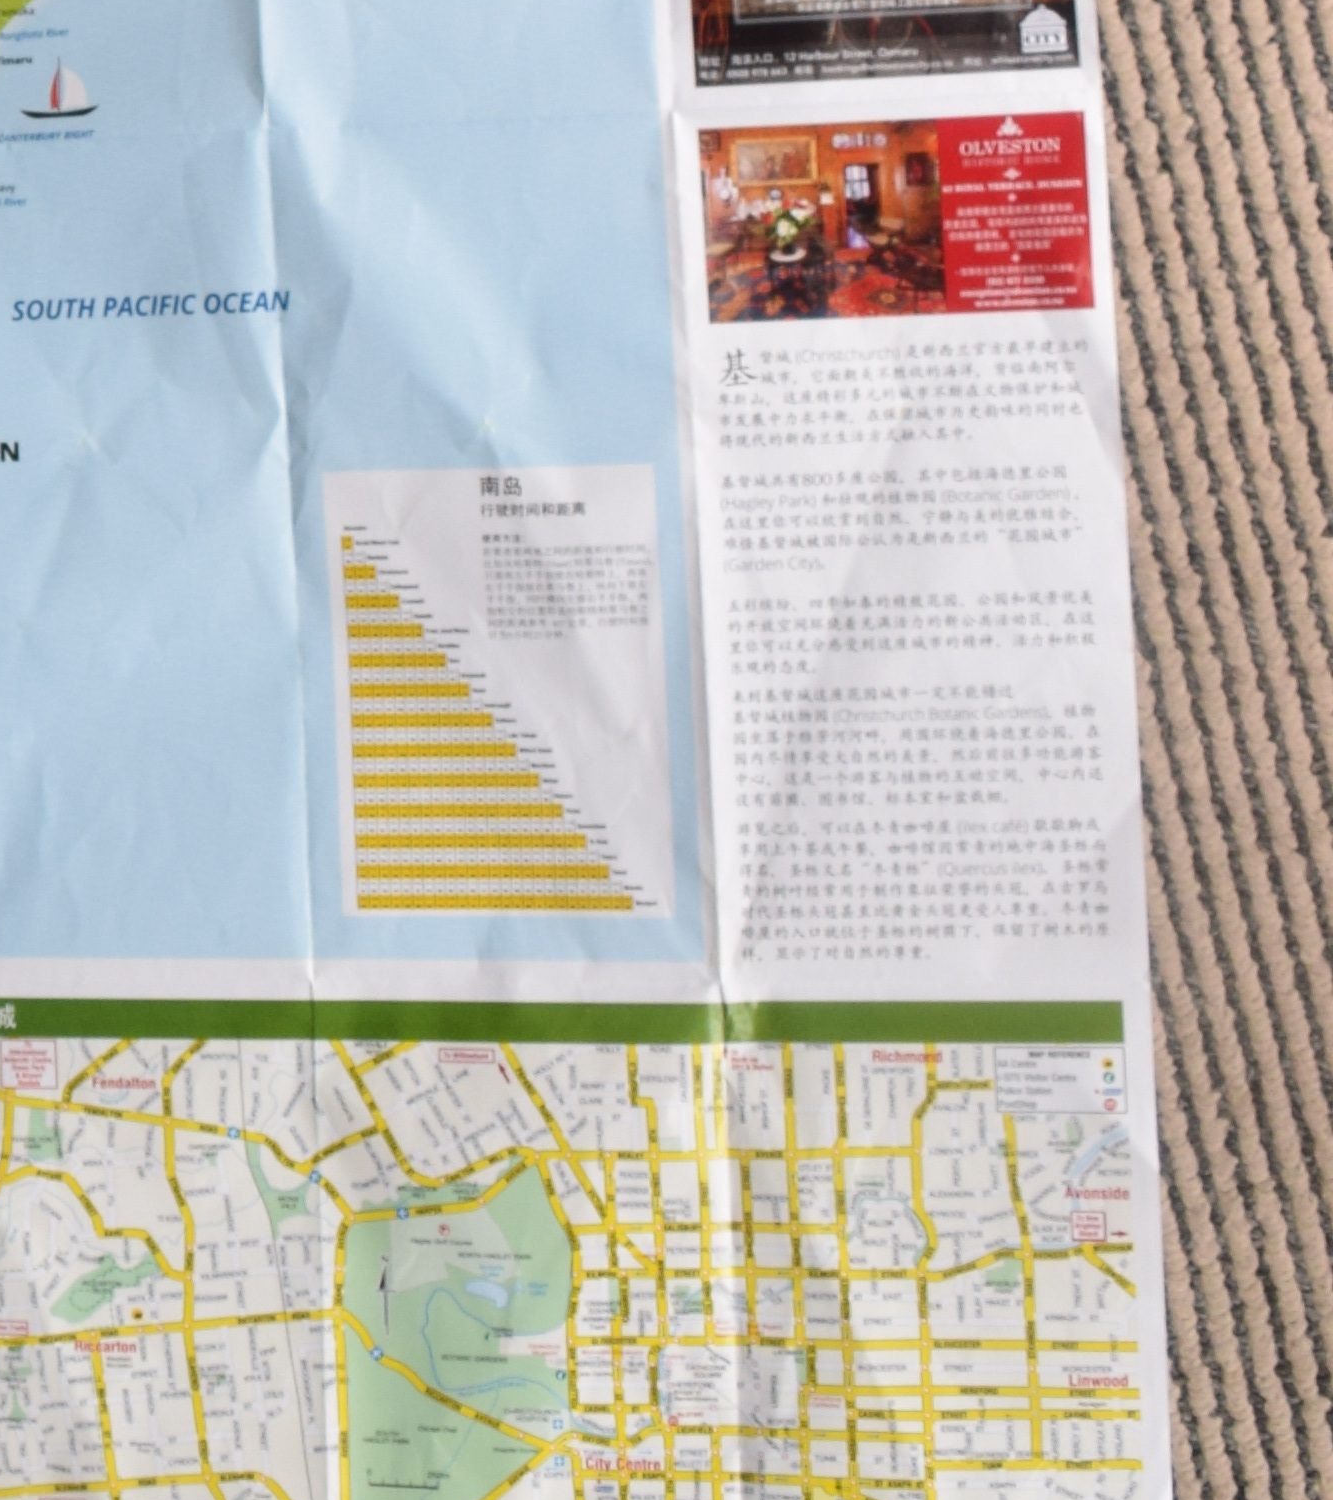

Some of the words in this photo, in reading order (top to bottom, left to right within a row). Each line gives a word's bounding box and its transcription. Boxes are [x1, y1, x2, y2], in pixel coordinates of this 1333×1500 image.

[959, 137, 1061, 156] OLVESTON
[12, 299, 95, 322] SOUTH
[102, 295, 197, 319] PACIFIC
[203, 291, 290, 316] OCEAN
[719, 348, 760, 389] 基
[479, 475, 522, 497] 南岛
[871, 1048, 944, 1065] Richmond
[91, 1075, 156, 1091] Fendalton
[1064, 1186, 1131, 1202] Avonside
[73, 1338, 138, 1355] Riccarton
[1068, 1374, 1130, 1390] Linwood
[585, 1457, 614, 1474] City
[616, 1456, 662, 1473] Centre
